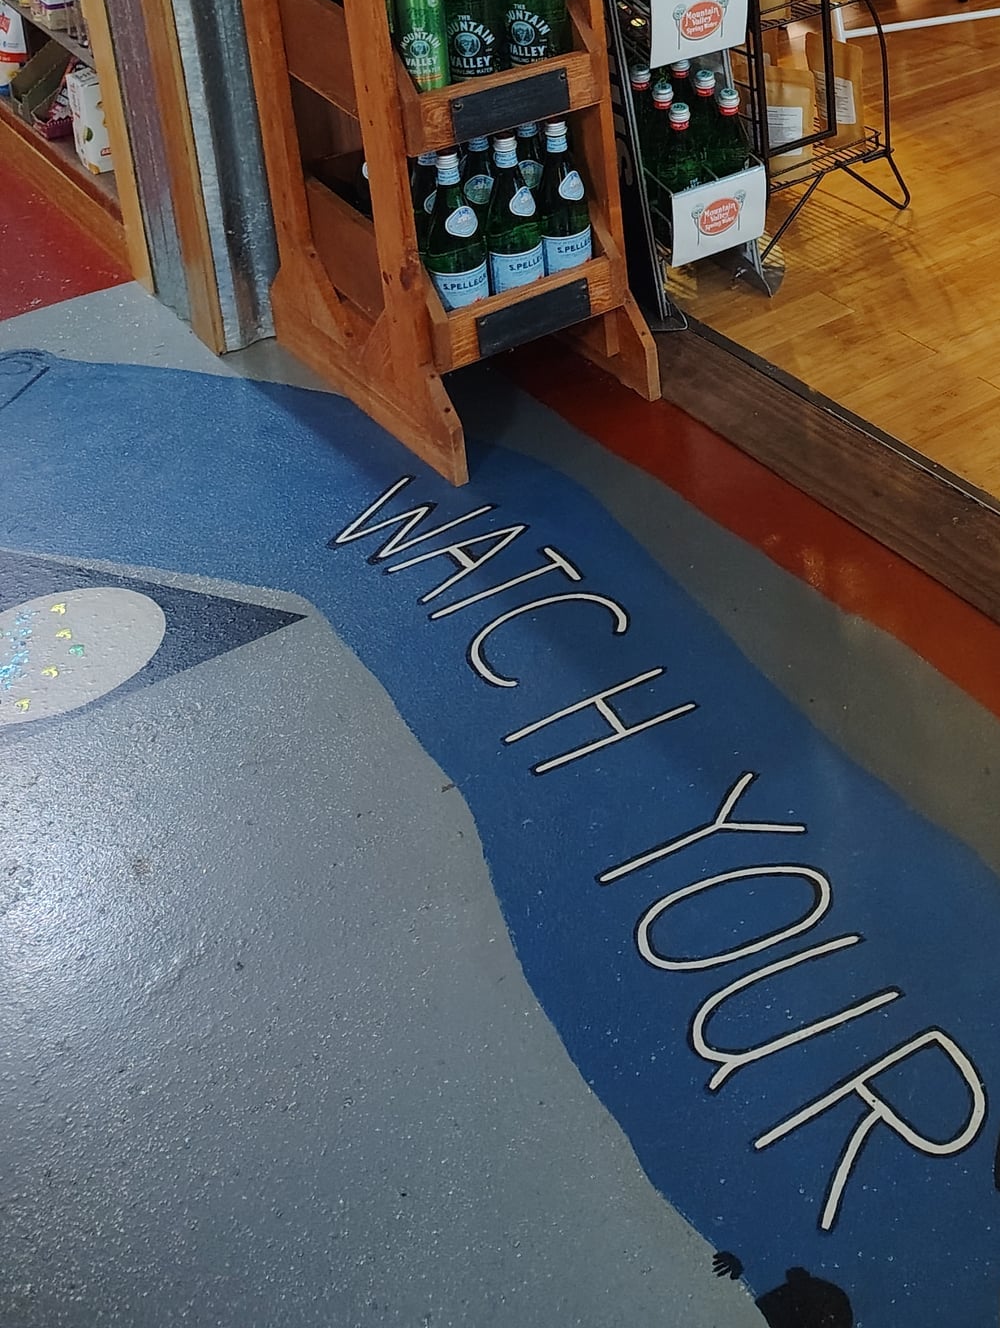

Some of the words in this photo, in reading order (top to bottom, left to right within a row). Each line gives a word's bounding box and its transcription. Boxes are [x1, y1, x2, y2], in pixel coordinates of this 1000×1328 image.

[507, 10, 551, 36] OUNTAIN
[685, 6, 720, 27] Mountain
[448, 21, 495, 46] OUNTAIN
[405, 56, 438, 67] VALLEY
[703, 202, 737, 225] Mountain
[327, 473, 700, 777] WATCH
[598, 769, 989, 1233] YOUR
